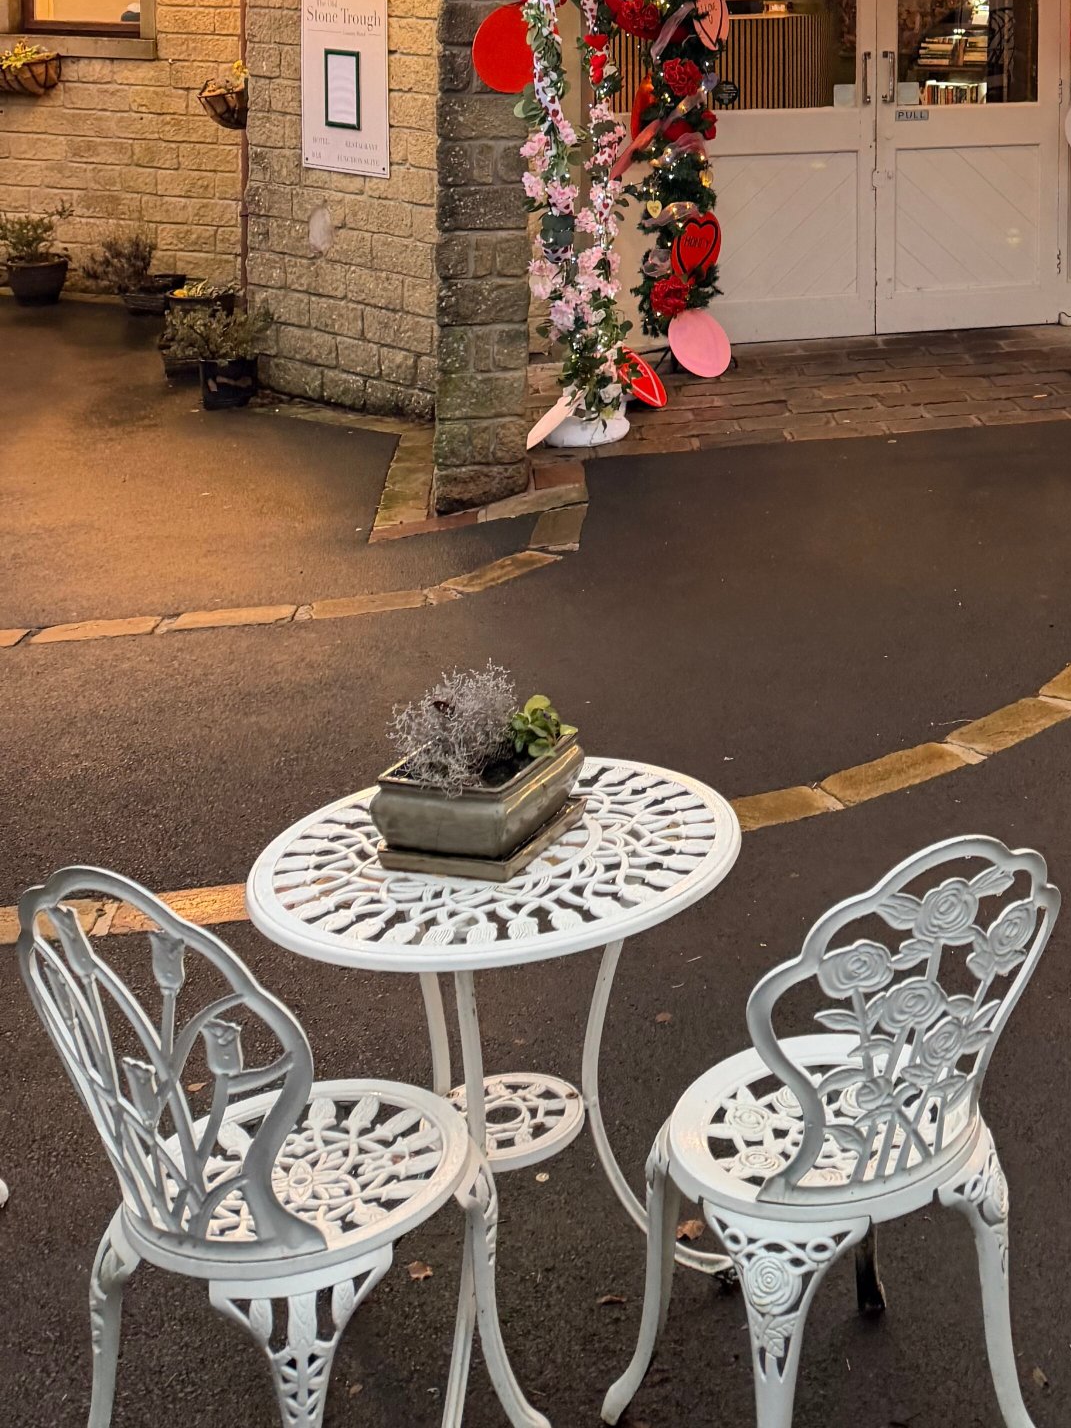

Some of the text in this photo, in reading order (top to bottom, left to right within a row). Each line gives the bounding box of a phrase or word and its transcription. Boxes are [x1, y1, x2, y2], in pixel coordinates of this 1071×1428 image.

[307, 5, 381, 32] Stone Trough
[897, 112, 926, 120] PULL
[684, 235, 710, 248] HONEY
